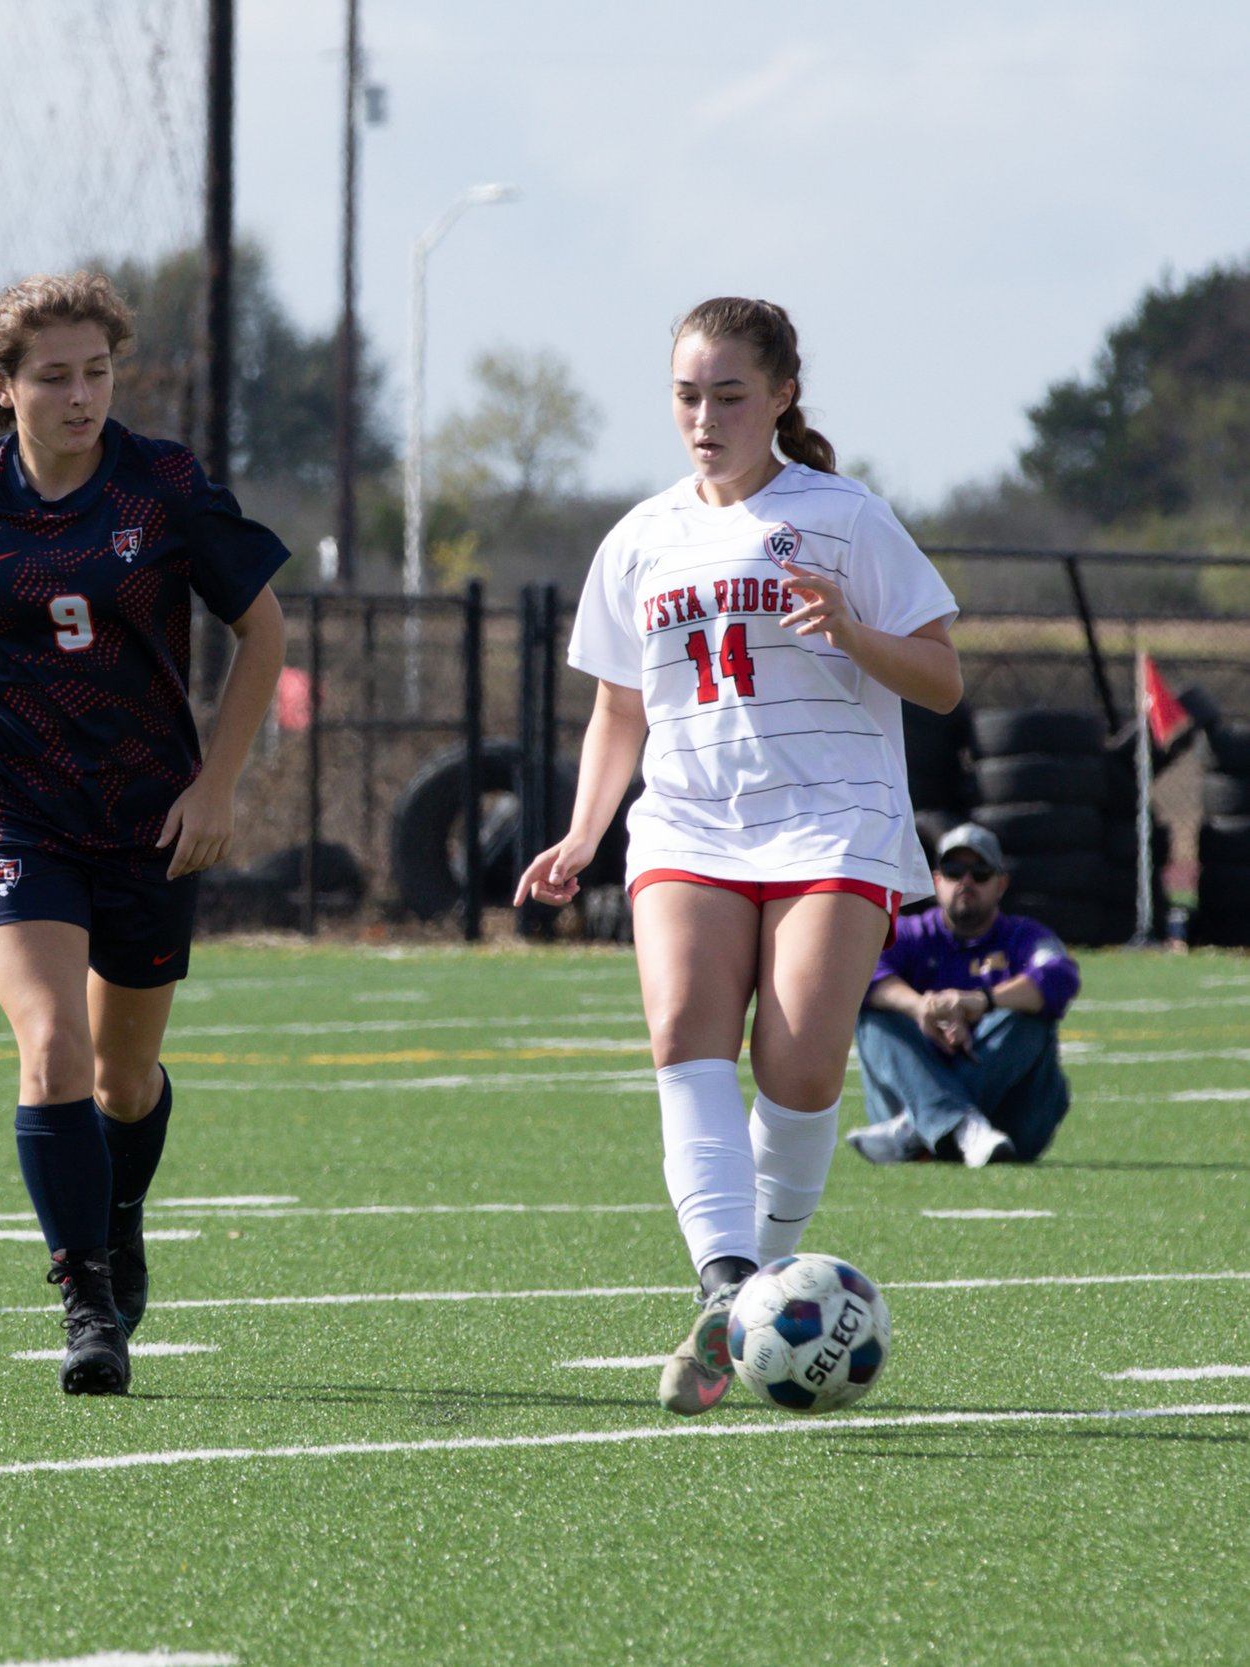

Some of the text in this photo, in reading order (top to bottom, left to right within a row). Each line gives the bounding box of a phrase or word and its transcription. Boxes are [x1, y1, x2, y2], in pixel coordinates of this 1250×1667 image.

[769, 537, 795, 556] VR
[49, 593, 95, 652] 9
[714, 578, 794, 613] RIDGE
[685, 623, 755, 705] 14
[804, 1299, 865, 1387] SELECT
